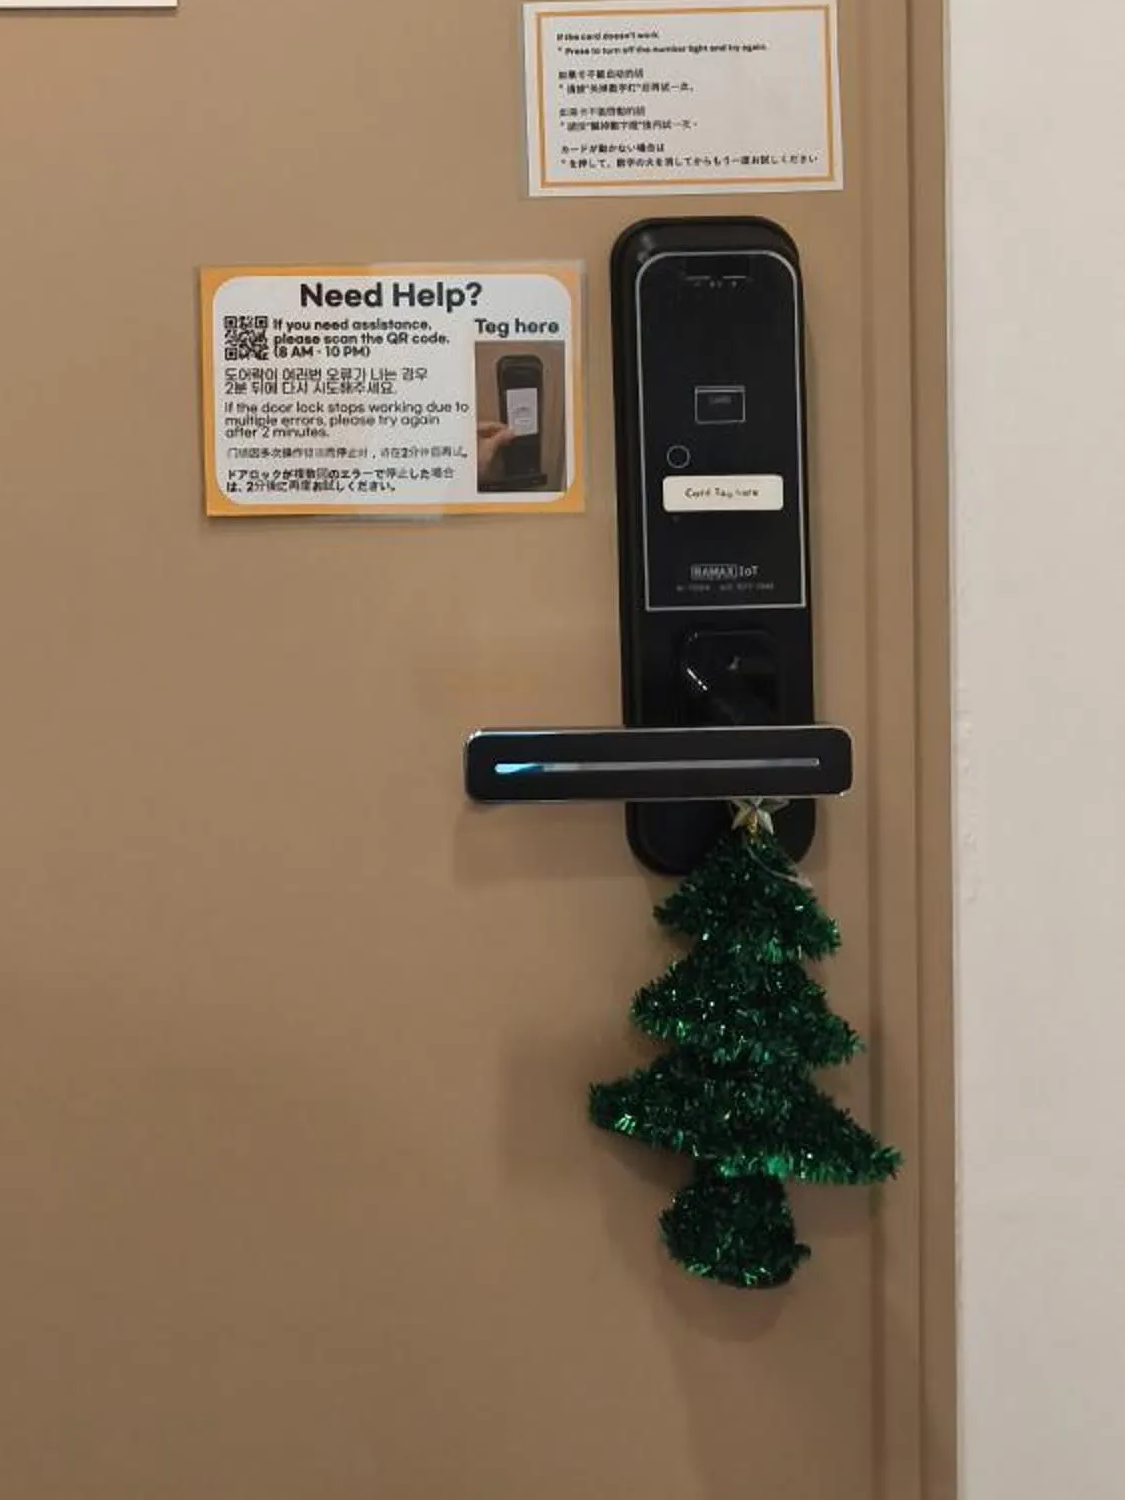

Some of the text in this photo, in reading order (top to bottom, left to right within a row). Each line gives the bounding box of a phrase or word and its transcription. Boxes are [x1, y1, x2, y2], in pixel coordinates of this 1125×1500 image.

[299, 281, 483, 313] Need Help?
[273, 318, 282, 332] If
[286, 321, 311, 334] you
[314, 318, 350, 332] need
[514, 317, 560, 334] here
[274, 330, 451, 348] please scan the QR code.
[273, 346, 288, 359] (8
[291, 345, 314, 359] AM
[324, 345, 341, 358] 10
[342, 344, 371, 358] PM)
[224, 367, 278, 382] 도어락이
[326, 367, 366, 382] 오류가
[402, 367, 428, 381] 경우
[224, 381, 248, 395] 2분
[251, 380, 278, 396] 뒤에
[282, 380, 309, 395] 다시
[236, 402, 258, 413] the
[261, 401, 294, 413] door
[295, 401, 325, 413] lock
[327, 402, 366, 415] stops
[368, 400, 423, 415] working
[426, 400, 452, 413] due
[455, 401, 470, 413] to
[224, 414, 278, 428] multiple
[329, 414, 376, 428] please
[378, 415, 398, 427] try
[400, 415, 440, 428] again
[225, 426, 258, 438] after
[261, 426, 271, 438] 2
